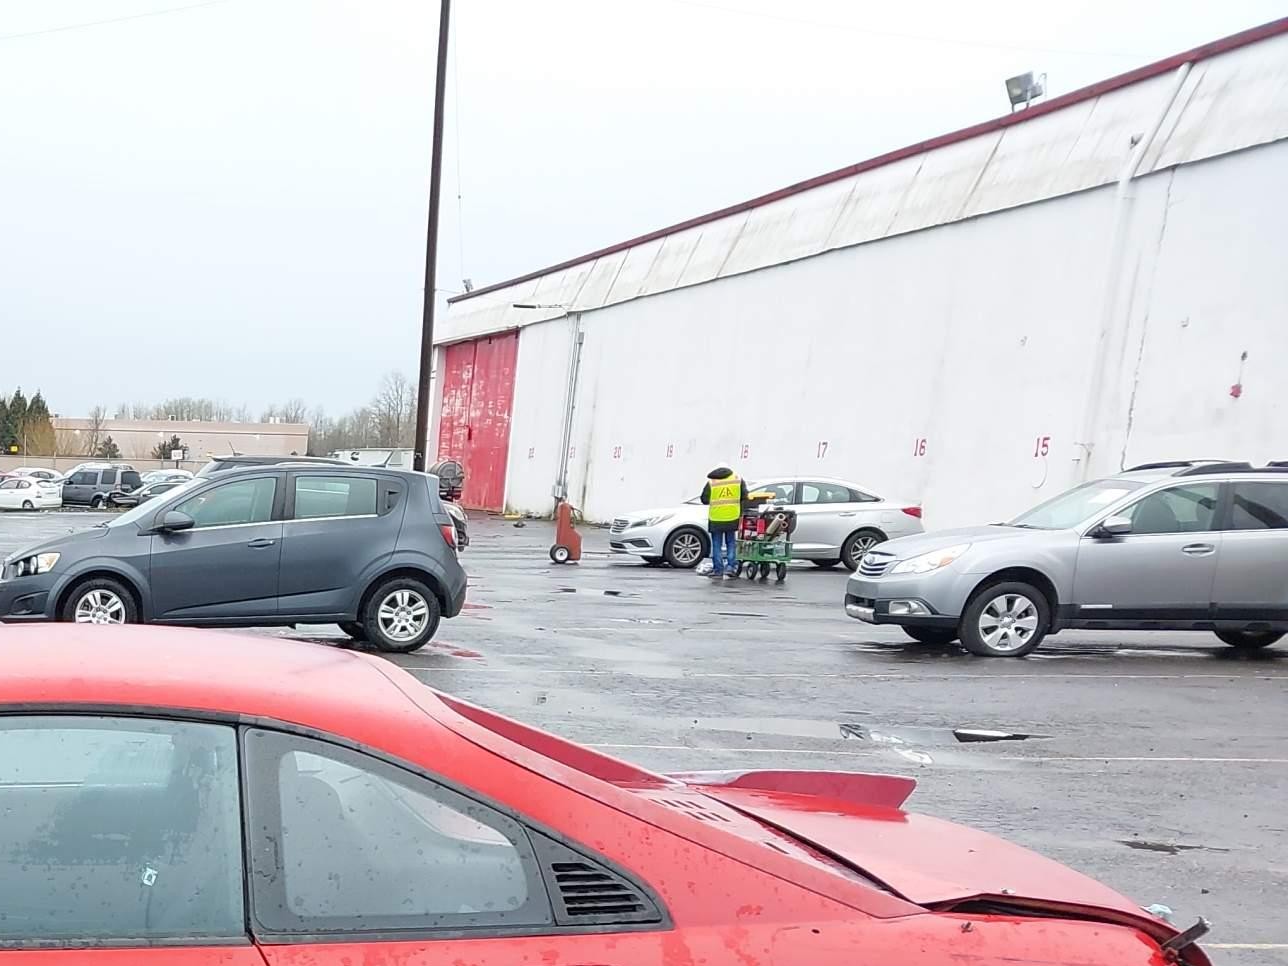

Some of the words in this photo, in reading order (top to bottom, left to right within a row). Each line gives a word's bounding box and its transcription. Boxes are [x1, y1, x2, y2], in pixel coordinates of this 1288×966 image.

[613, 446, 622, 459] 20
[817, 441, 828, 458] 17
[914, 438, 927, 456] 16
[1034, 437, 1051, 457] 15
